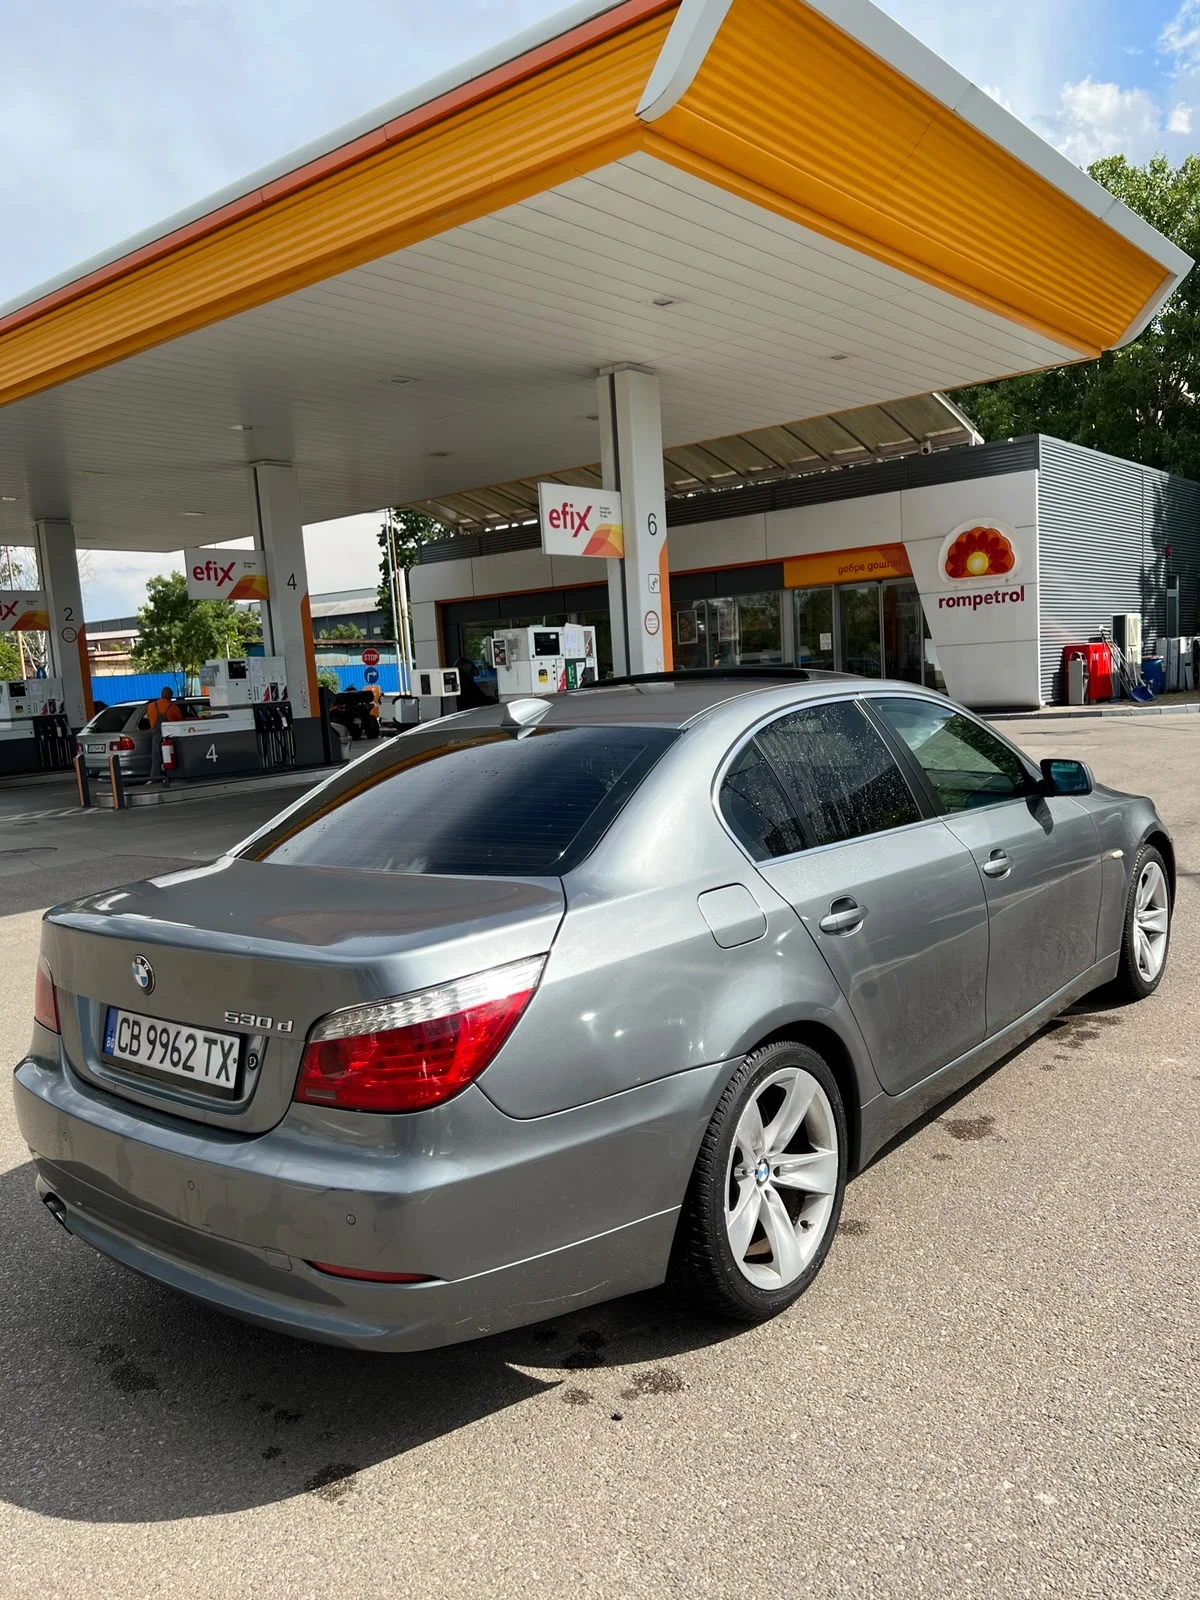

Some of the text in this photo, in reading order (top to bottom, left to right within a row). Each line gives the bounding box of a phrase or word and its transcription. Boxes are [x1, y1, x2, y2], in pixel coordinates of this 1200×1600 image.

[548, 502, 593, 538] efix
[647, 512, 658, 536] 6
[192, 560, 237, 587] efix
[837, 562, 866, 576] добре
[286, 573, 298, 590] 4
[938, 585, 1025, 611] rompetrol
[63, 606, 75, 622] 2
[363, 653, 379, 662] STOP
[205, 743, 218, 763] 4
[146, 1025, 198, 1073] 9962
